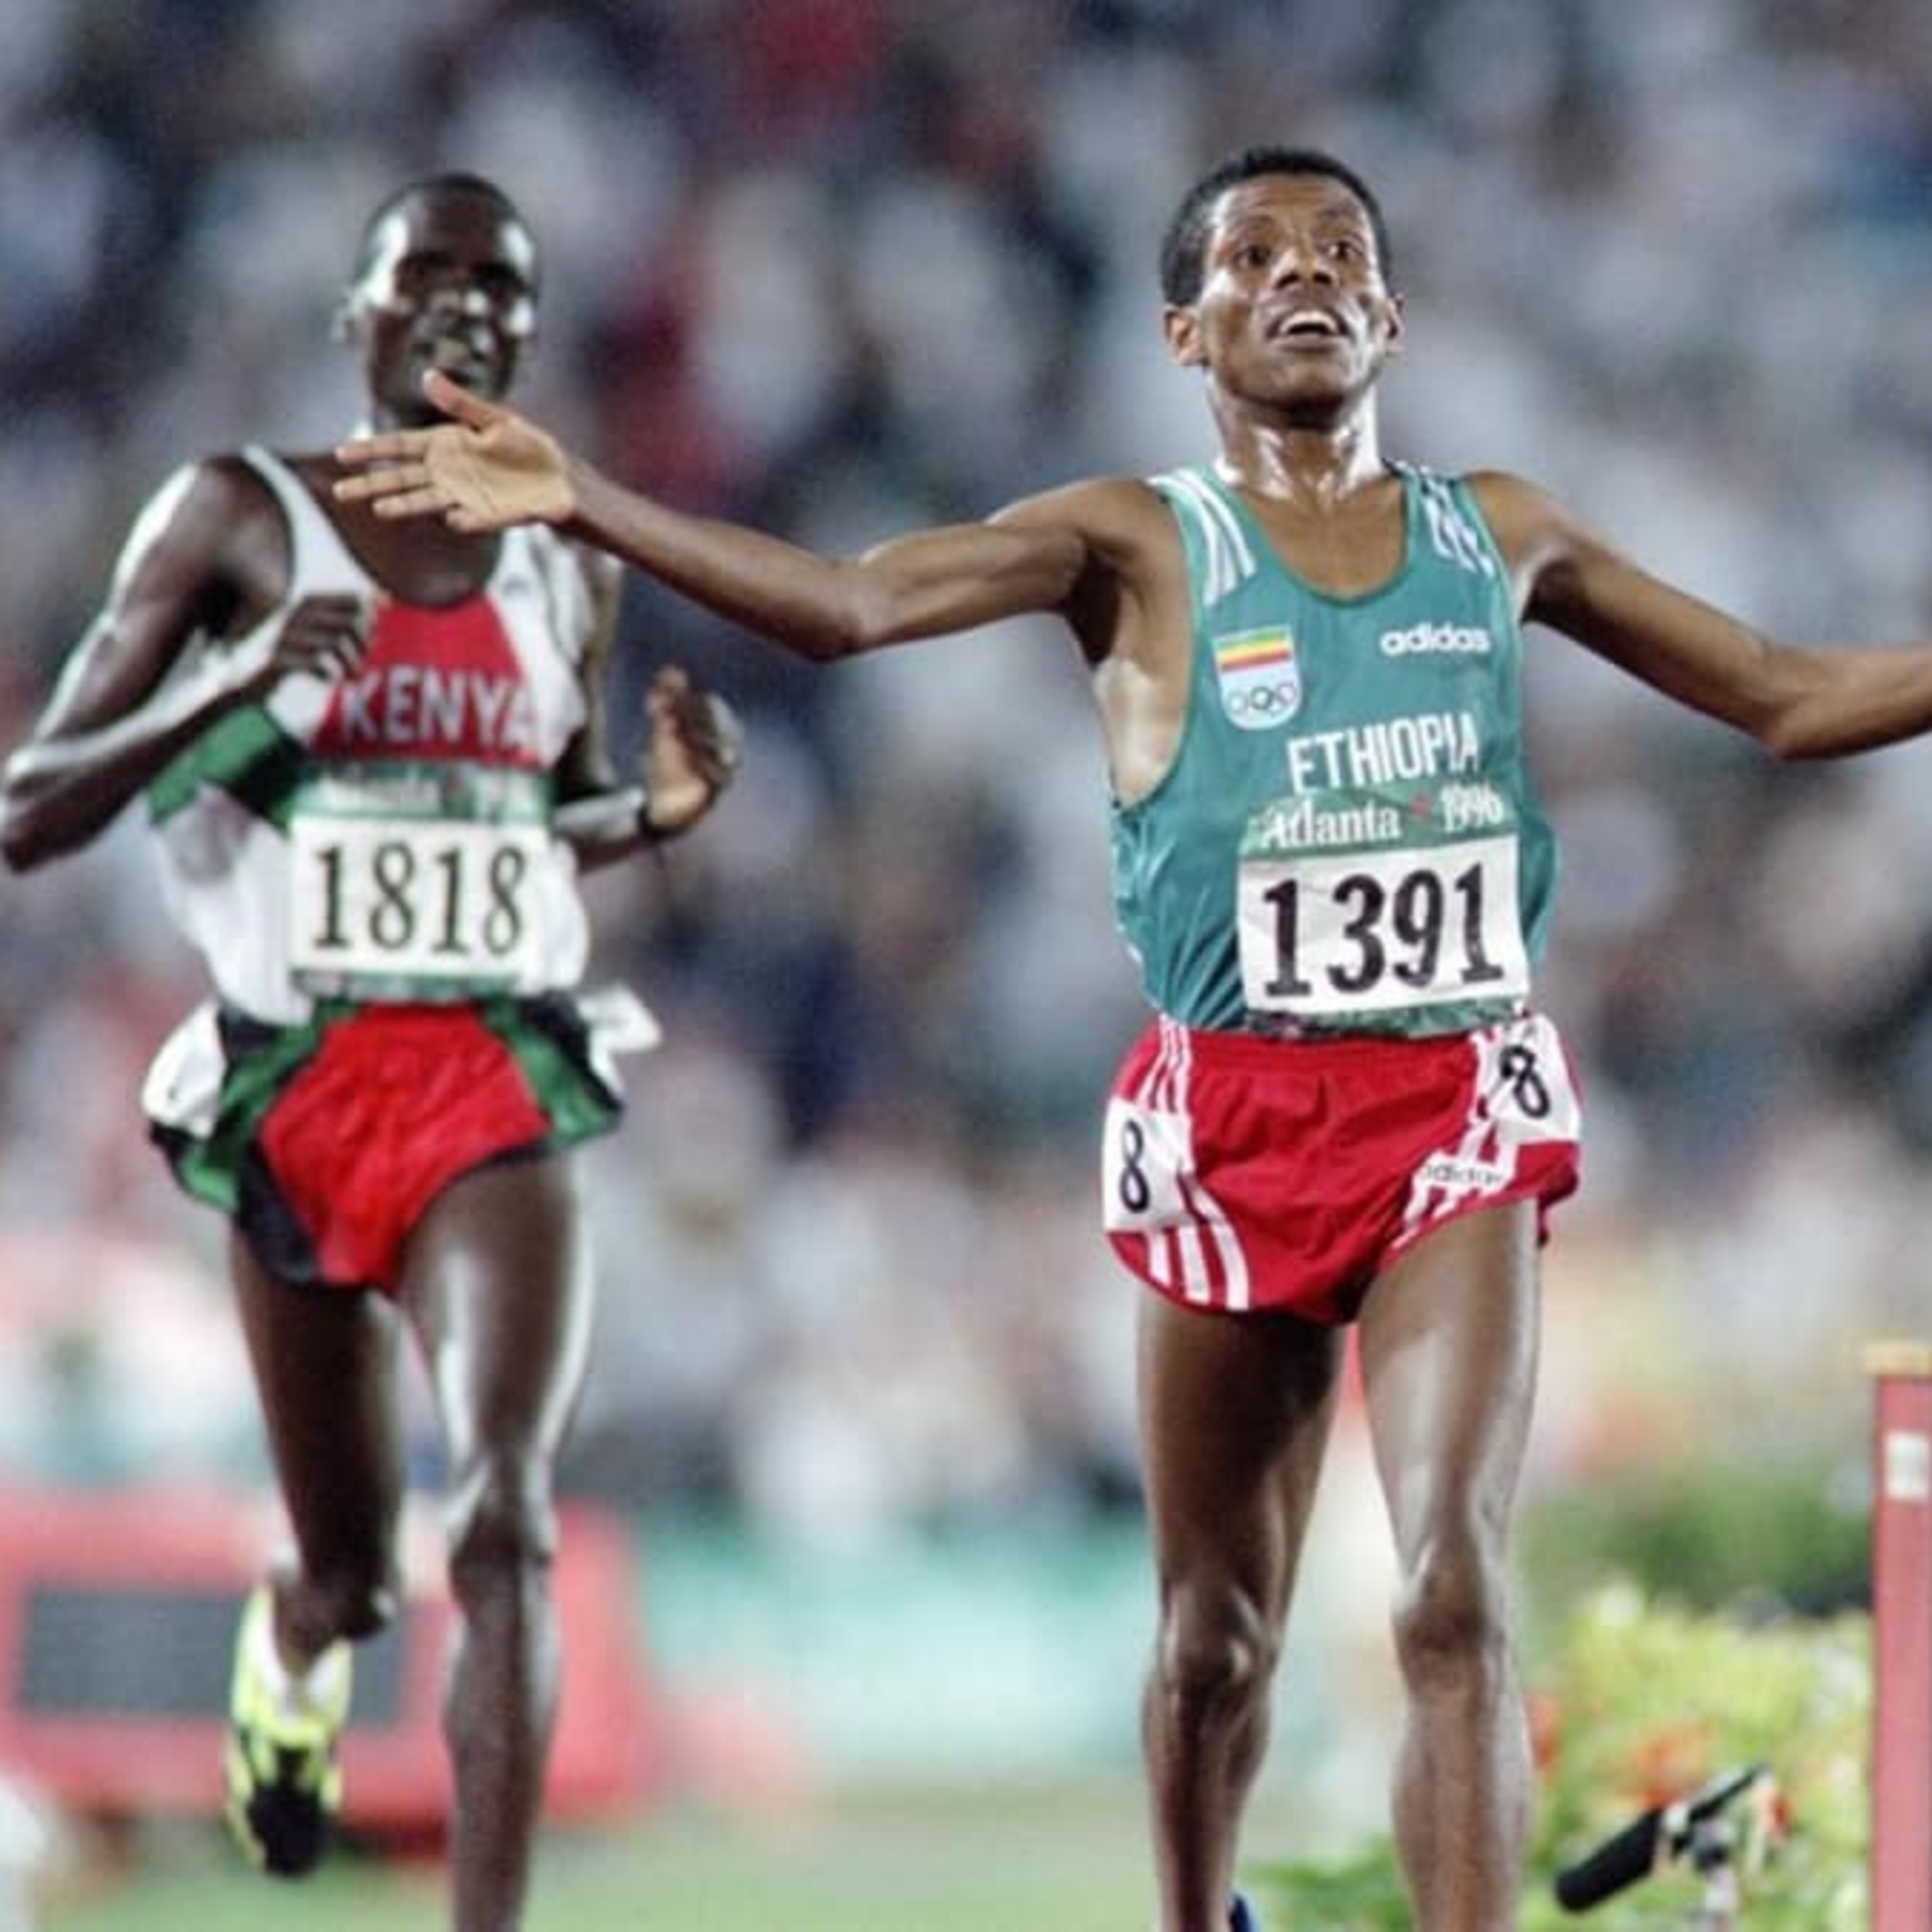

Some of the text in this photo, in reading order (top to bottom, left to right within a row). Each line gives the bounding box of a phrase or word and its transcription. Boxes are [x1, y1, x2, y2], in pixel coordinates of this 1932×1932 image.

[1381, 622, 1490, 655] adidas
[340, 665, 536, 748] KENYA
[1289, 712, 1479, 795] ETHIOPIA
[1260, 797, 1402, 848] Atlanta
[314, 842, 526, 956] 1818
[1263, 861, 1504, 997] 1391
[1500, 1045, 1551, 1119] 8
[1119, 1119, 1150, 1214] 8
